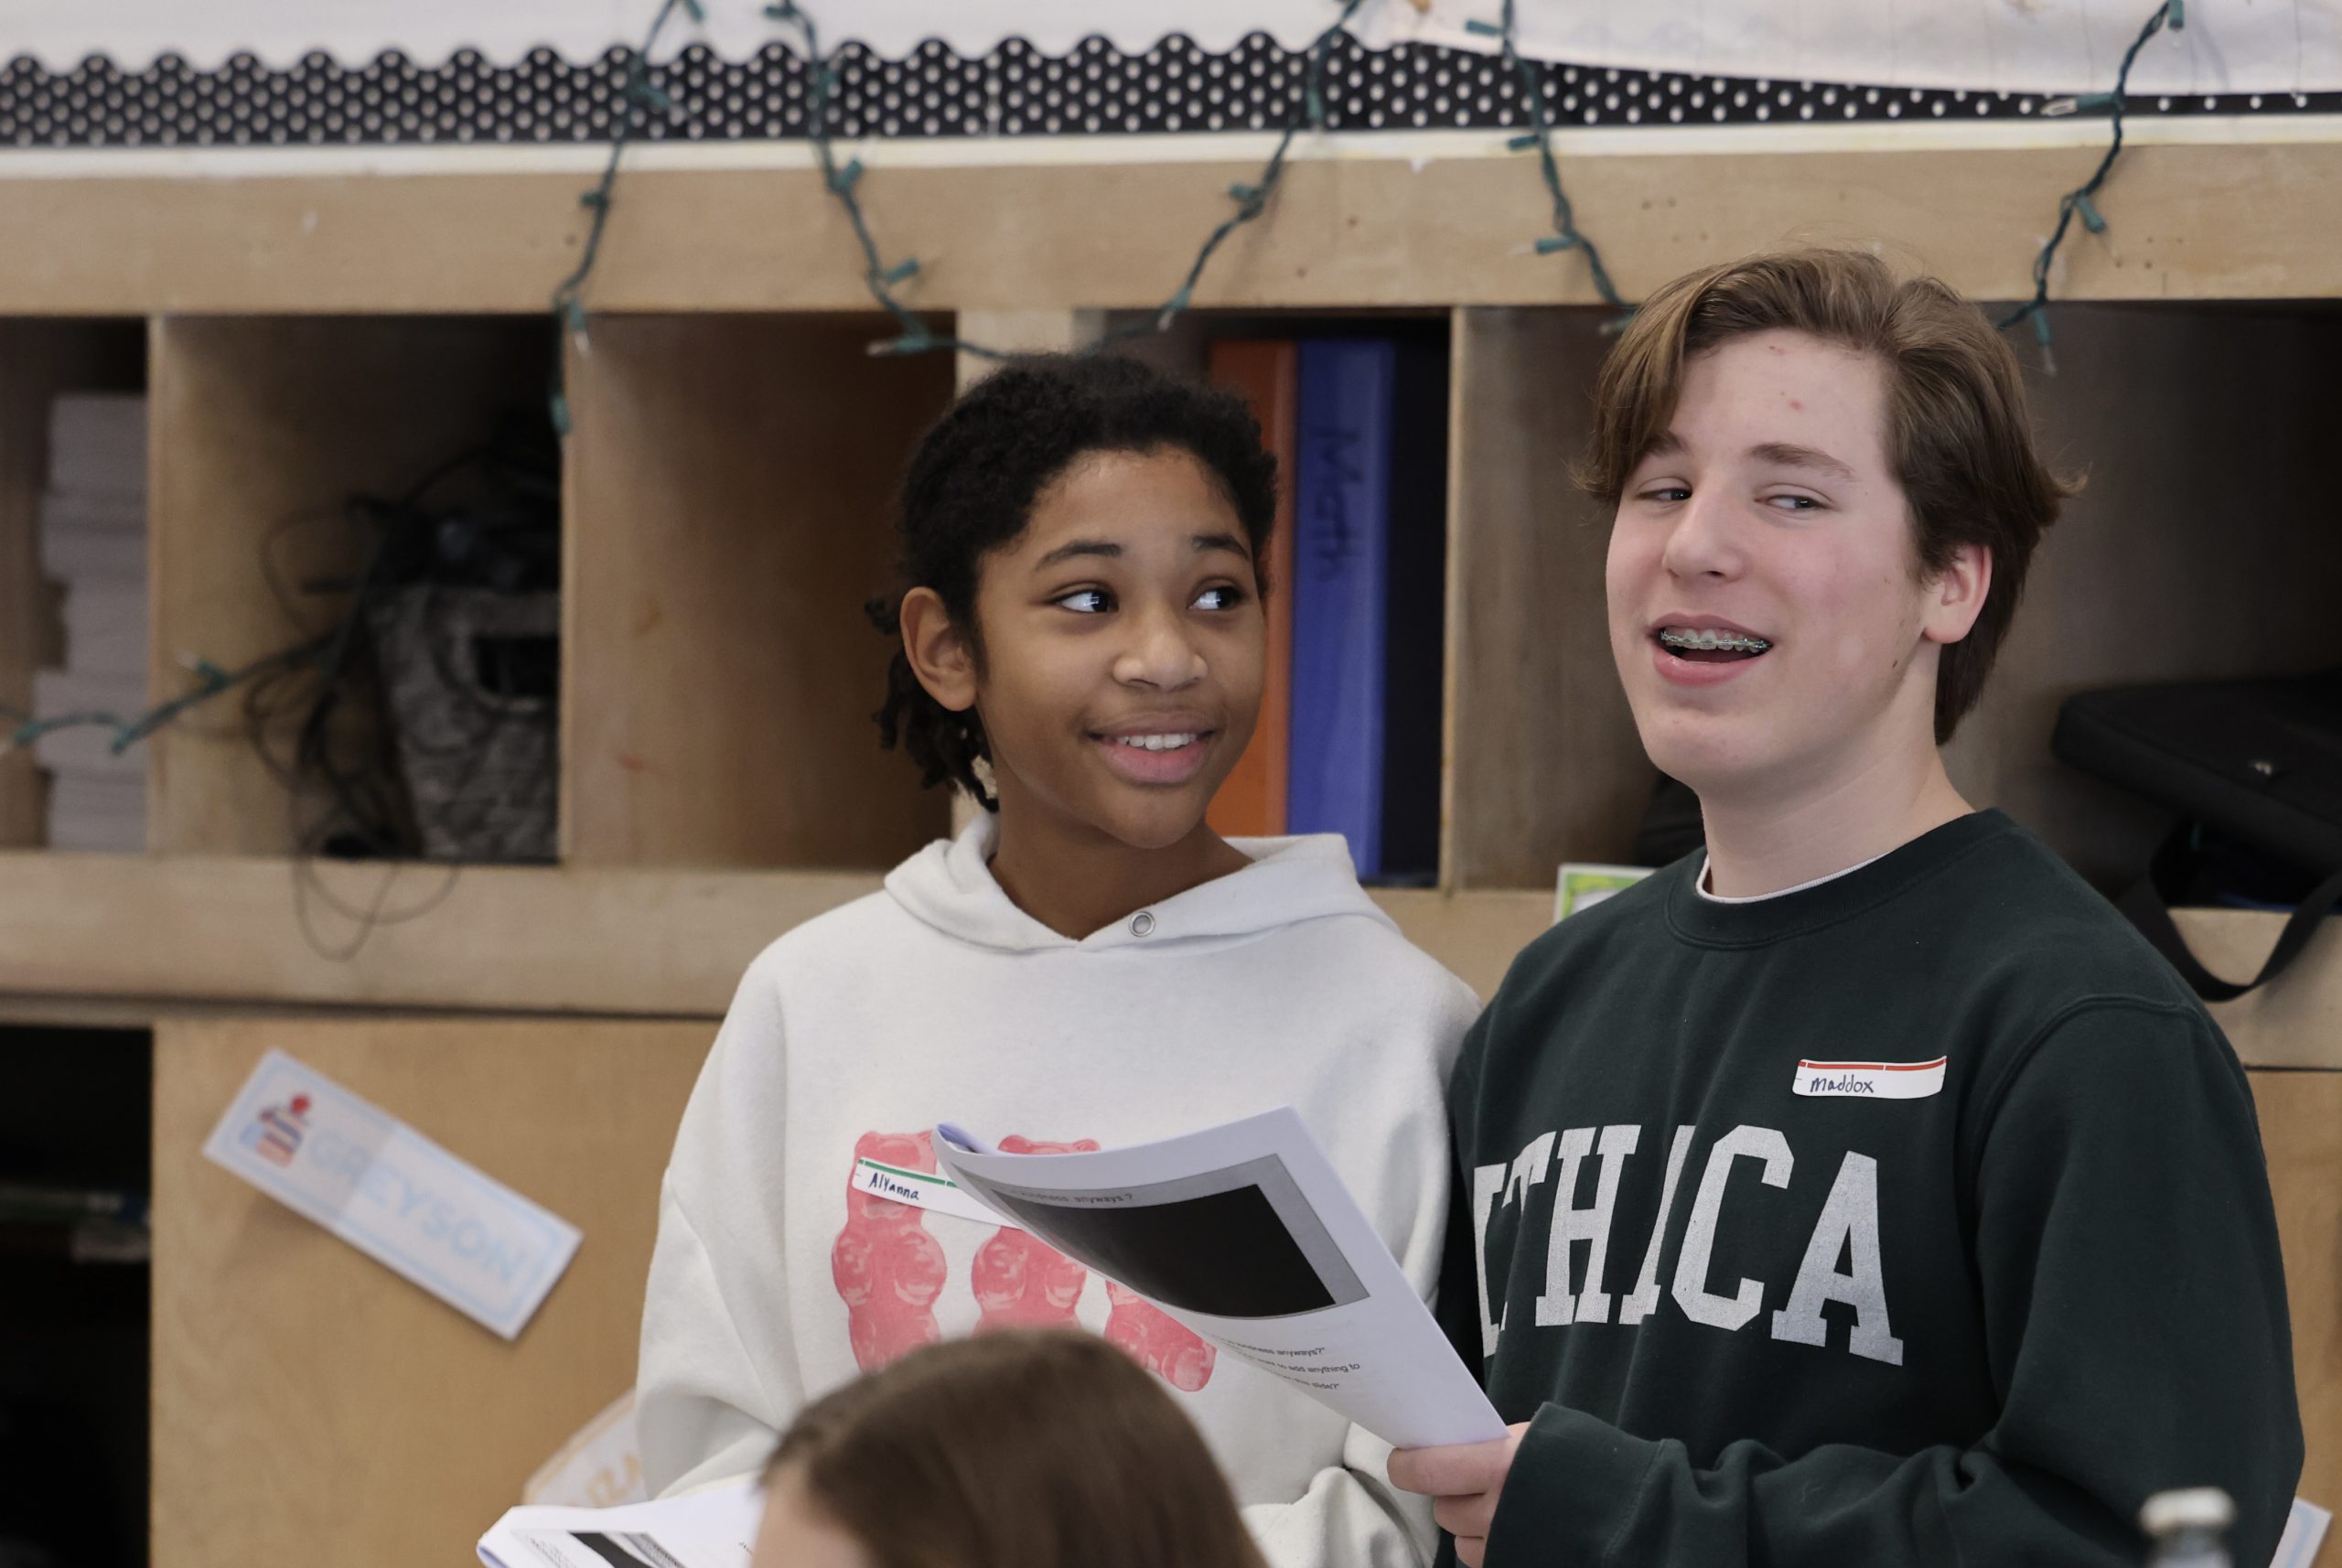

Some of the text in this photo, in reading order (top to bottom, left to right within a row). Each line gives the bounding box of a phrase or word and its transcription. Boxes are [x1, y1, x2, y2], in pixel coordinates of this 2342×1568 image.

[1310, 428, 1363, 582] Math
[308, 1129, 527, 1284] GREYSON
[1307, 1364, 1349, 1375] anything
[1348, 1362, 1361, 1370] to
